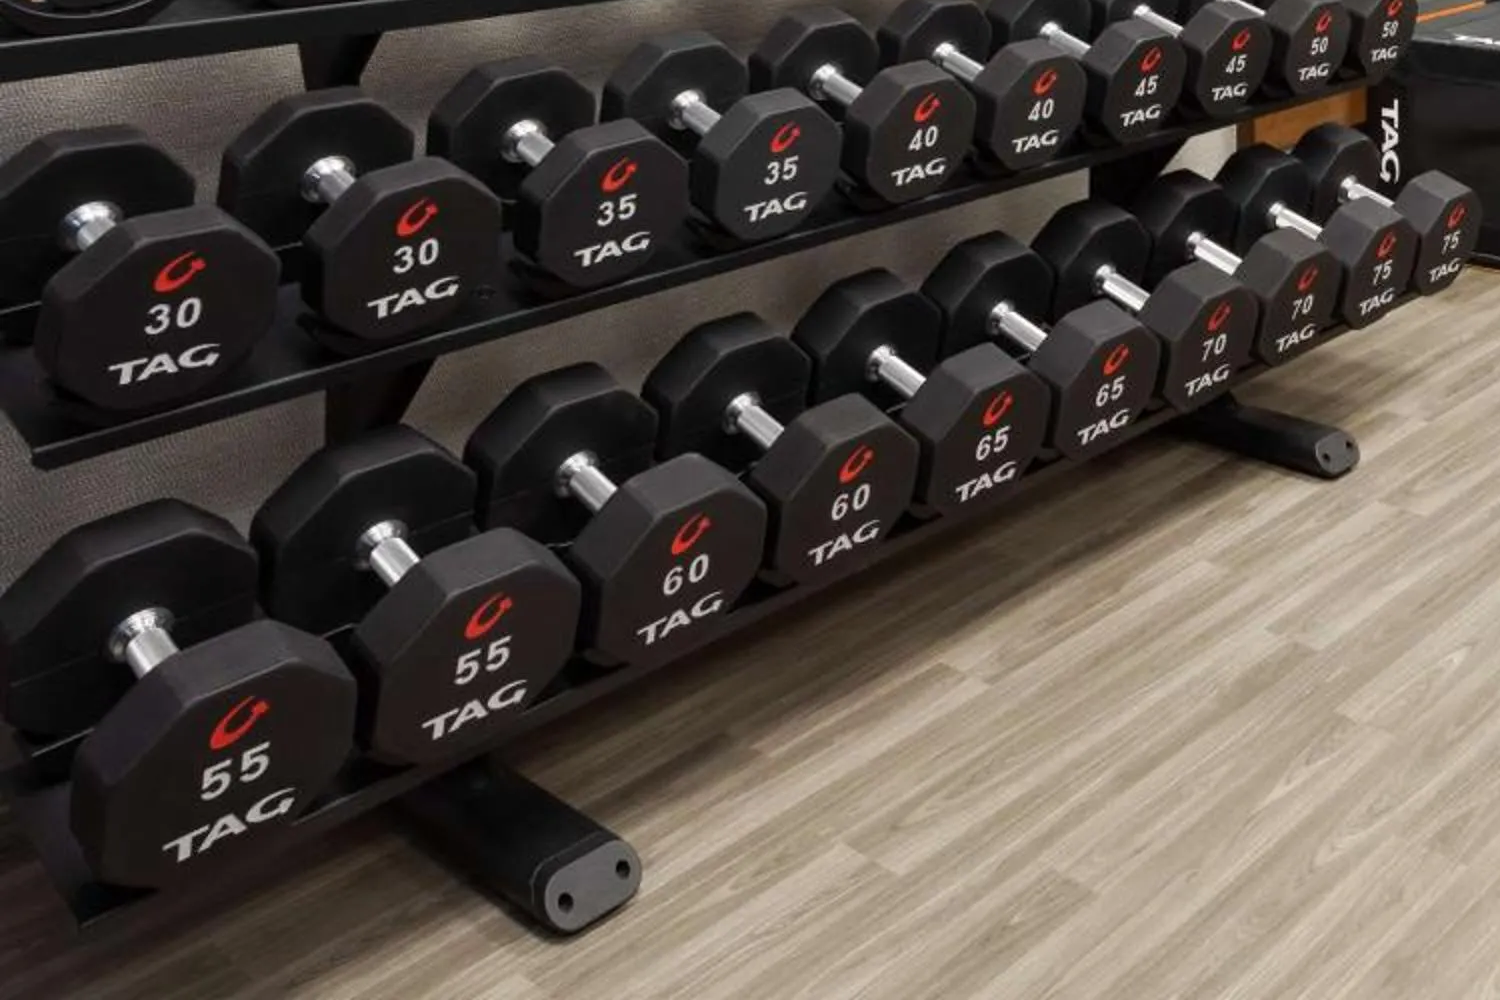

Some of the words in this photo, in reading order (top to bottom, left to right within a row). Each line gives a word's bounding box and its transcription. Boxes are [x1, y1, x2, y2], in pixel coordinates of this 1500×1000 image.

[1381, 20, 1399, 39] 50
[1310, 36, 1329, 56] 50
[1371, 45, 1399, 63] TAG
[1225, 53, 1247, 74] 45
[1298, 62, 1330, 81] TAG
[1134, 74, 1159, 97] 45
[1211, 82, 1247, 102] TAG
[1027, 97, 1055, 121] 40
[1120, 103, 1161, 127] TAG
[908, 125, 939, 151] 40
[1011, 129, 1058, 153] TAG
[1380, 98, 1399, 184] TAG
[764, 155, 799, 185] 35
[891, 157, 946, 186] TAG
[596, 193, 637, 227] 35
[743, 191, 807, 223] TAG
[393, 237, 439, 274] 30
[574, 231, 650, 267] TAG
[1441, 229, 1461, 254] 75
[1373, 259, 1393, 286] 75
[1429, 257, 1460, 283] TAG
[367, 276, 459, 319] TAG
[1291, 293, 1314, 320] 70
[1359, 287, 1394, 316] TAG
[144, 297, 202, 335] 30
[1201, 333, 1227, 362] 70
[1275, 323, 1315, 353] TAG
[108, 343, 220, 385] TAG
[1184, 363, 1230, 397] TAG
[1095, 375, 1126, 408] 65
[1077, 408, 1129, 445] TAG
[975, 425, 1011, 461] 65
[955, 461, 1016, 502] TAG
[831, 483, 871, 521] 60
[807, 519, 880, 566] TAG
[663, 553, 709, 596] 60
[637, 591, 723, 645] TAG
[454, 635, 512, 685] 55
[421, 679, 527, 741] TAG
[200, 741, 271, 801] 55
[162, 787, 295, 862] TAG
